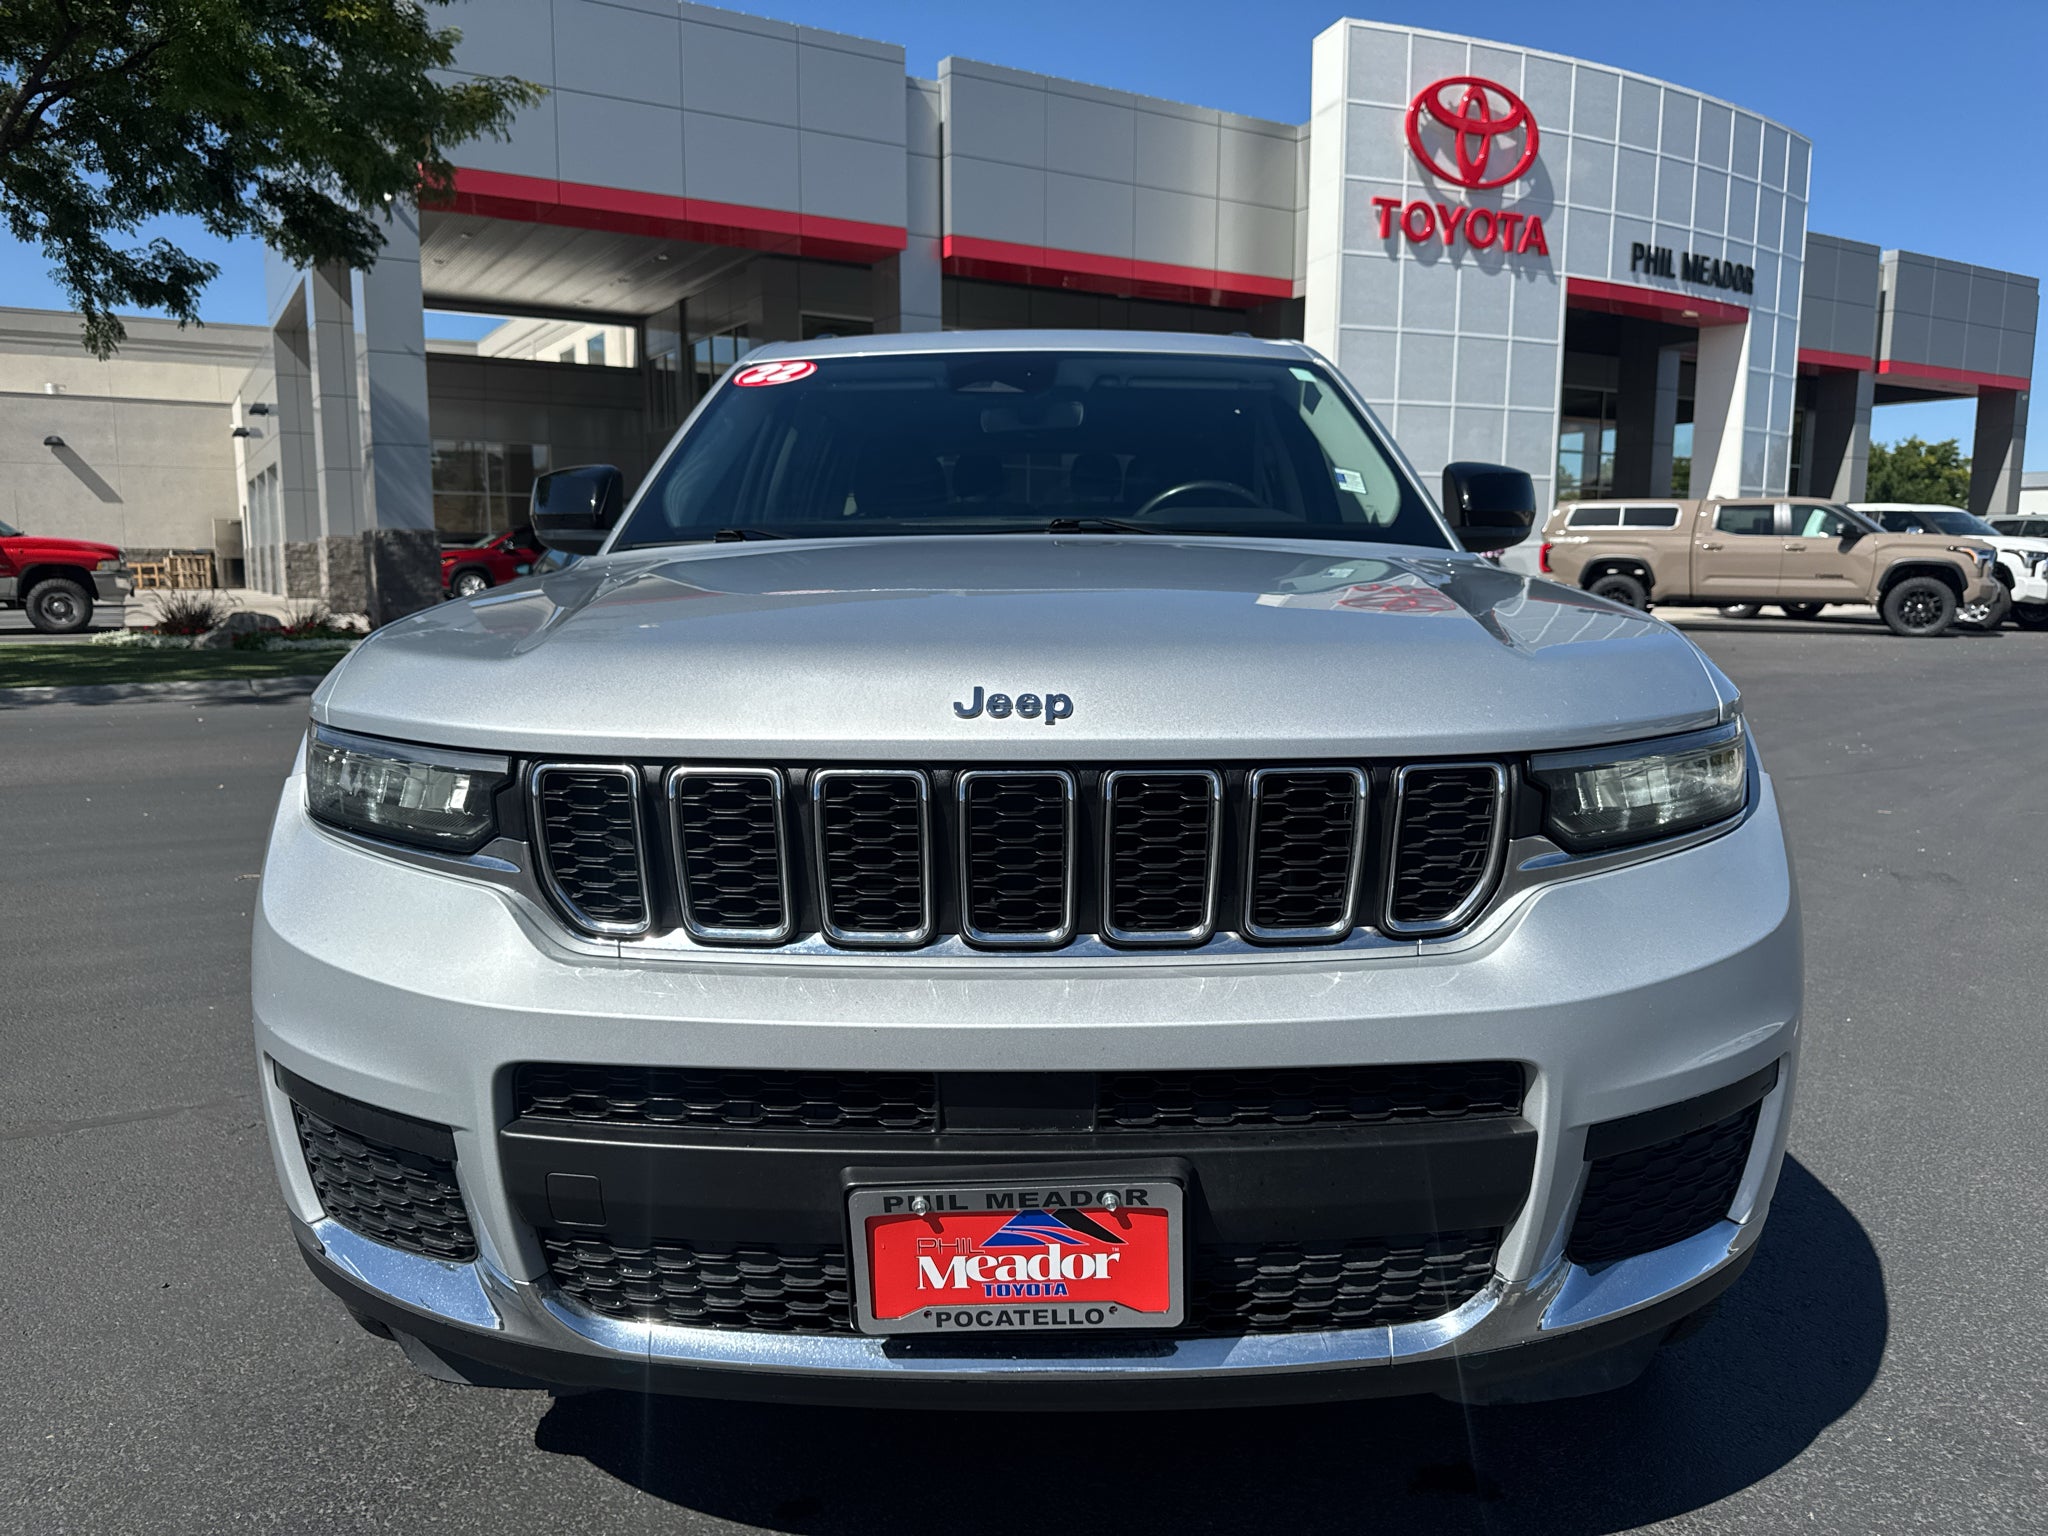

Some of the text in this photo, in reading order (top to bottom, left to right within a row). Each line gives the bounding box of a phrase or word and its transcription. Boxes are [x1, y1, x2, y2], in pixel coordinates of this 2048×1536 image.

[1371, 196, 1549, 257] TOYOTA
[1631, 242, 1756, 295] PHIL MEADOR
[953, 686, 1074, 725] Jeep
[985, 1189, 1149, 1209] MEADOR
[917, 1237, 986, 1255] PHIL
[916, 1243, 1121, 1290] Meador
[983, 1282, 1069, 1297] TOYOTA
[935, 1307, 1105, 1328] POCATELLO
